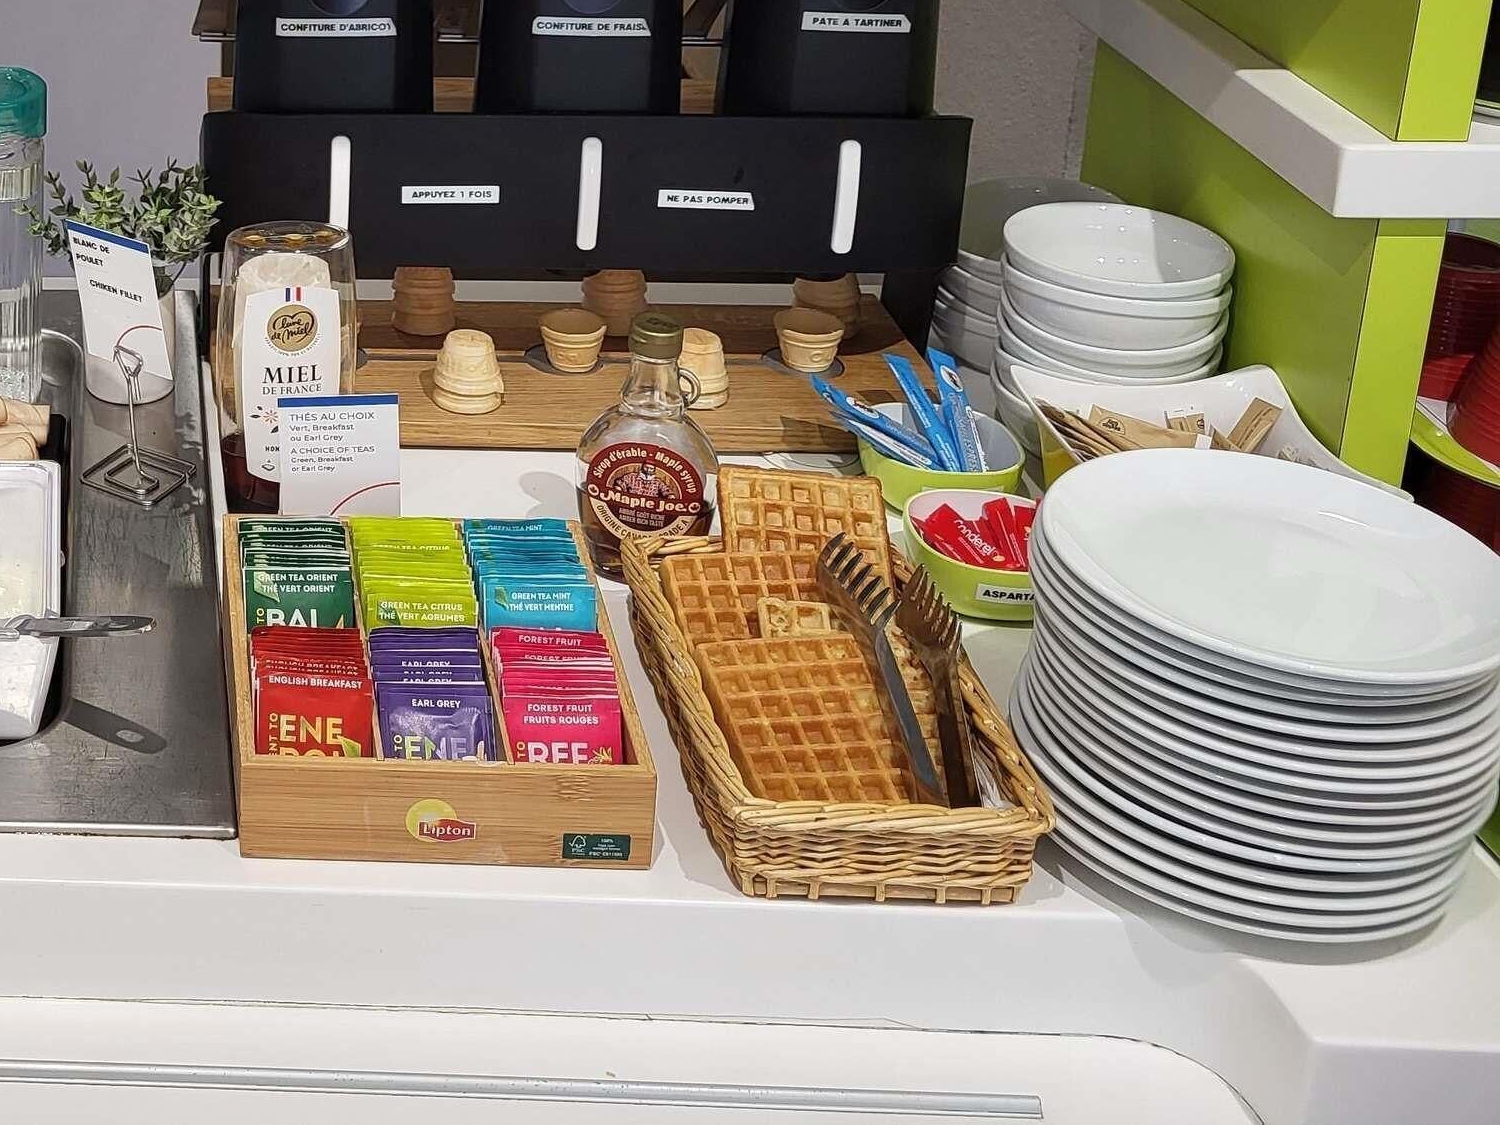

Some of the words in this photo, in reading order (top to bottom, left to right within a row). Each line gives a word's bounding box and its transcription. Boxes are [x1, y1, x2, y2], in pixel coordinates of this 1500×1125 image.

[280, 23, 336, 32] CONFITURE
[536, 21, 594, 31] CONFITURE
[597, 22, 611, 31] DE
[854, 19, 902, 27] TARTINER
[412, 190, 456, 199] APPUYEZ
[460, 190, 465, 199] 1
[468, 190, 492, 198] FOIS
[666, 195, 680, 203] NE
[683, 195, 703, 203] PAS
[706, 196, 749, 205] POMPER
[72, 236, 97, 250] BLANC
[76, 253, 104, 267] POULET
[262, 364, 322, 384] MIEL
[262, 386, 277, 395] DE
[280, 384, 322, 395] FRANCE
[289, 411, 318, 422] THÉS
[320, 413, 336, 421] AU
[339, 411, 375, 420] CHOIX
[312, 423, 355, 431] Breakfast
[323, 434, 344, 443] Grey
[290, 447, 298, 455] A
[299, 446, 335, 455] CHOICE
[317, 465, 335, 473] Grey
[593, 459, 611, 479] Sirop
[655, 452, 684, 472] Maple
[679, 469, 697, 494] syrup
[600, 489, 655, 509] Maple
[656, 501, 687, 513] Joe
[597, 505, 621, 532] ORIGINE
[307, 574, 338, 582] ORIENT
[280, 584, 301, 592] VERT
[303, 585, 335, 593] ORIENT
[511, 592, 536, 600] GREEN
[537, 592, 552, 600] TEA
[553, 592, 571, 600] MINT
[380, 602, 410, 610] GREEN
[430, 603, 463, 611] CITRUS
[525, 603, 544, 611] VERT
[544, 603, 574, 611] MENTHE
[421, 614, 465, 622] AGRUMES
[518, 634, 553, 645] FOREST
[555, 636, 582, 646] FRUIT
[268, 676, 309, 686] ENGLISH
[310, 678, 362, 689] BREAKFAST
[411, 698, 435, 707] EARL
[436, 699, 461, 708] GREY
[527, 704, 564, 712] FOREST
[566, 704, 593, 712] FRUIT
[523, 716, 556, 724] FRUITS
[559, 716, 599, 725] ROUGES
[423, 823, 471, 837] Lipton
